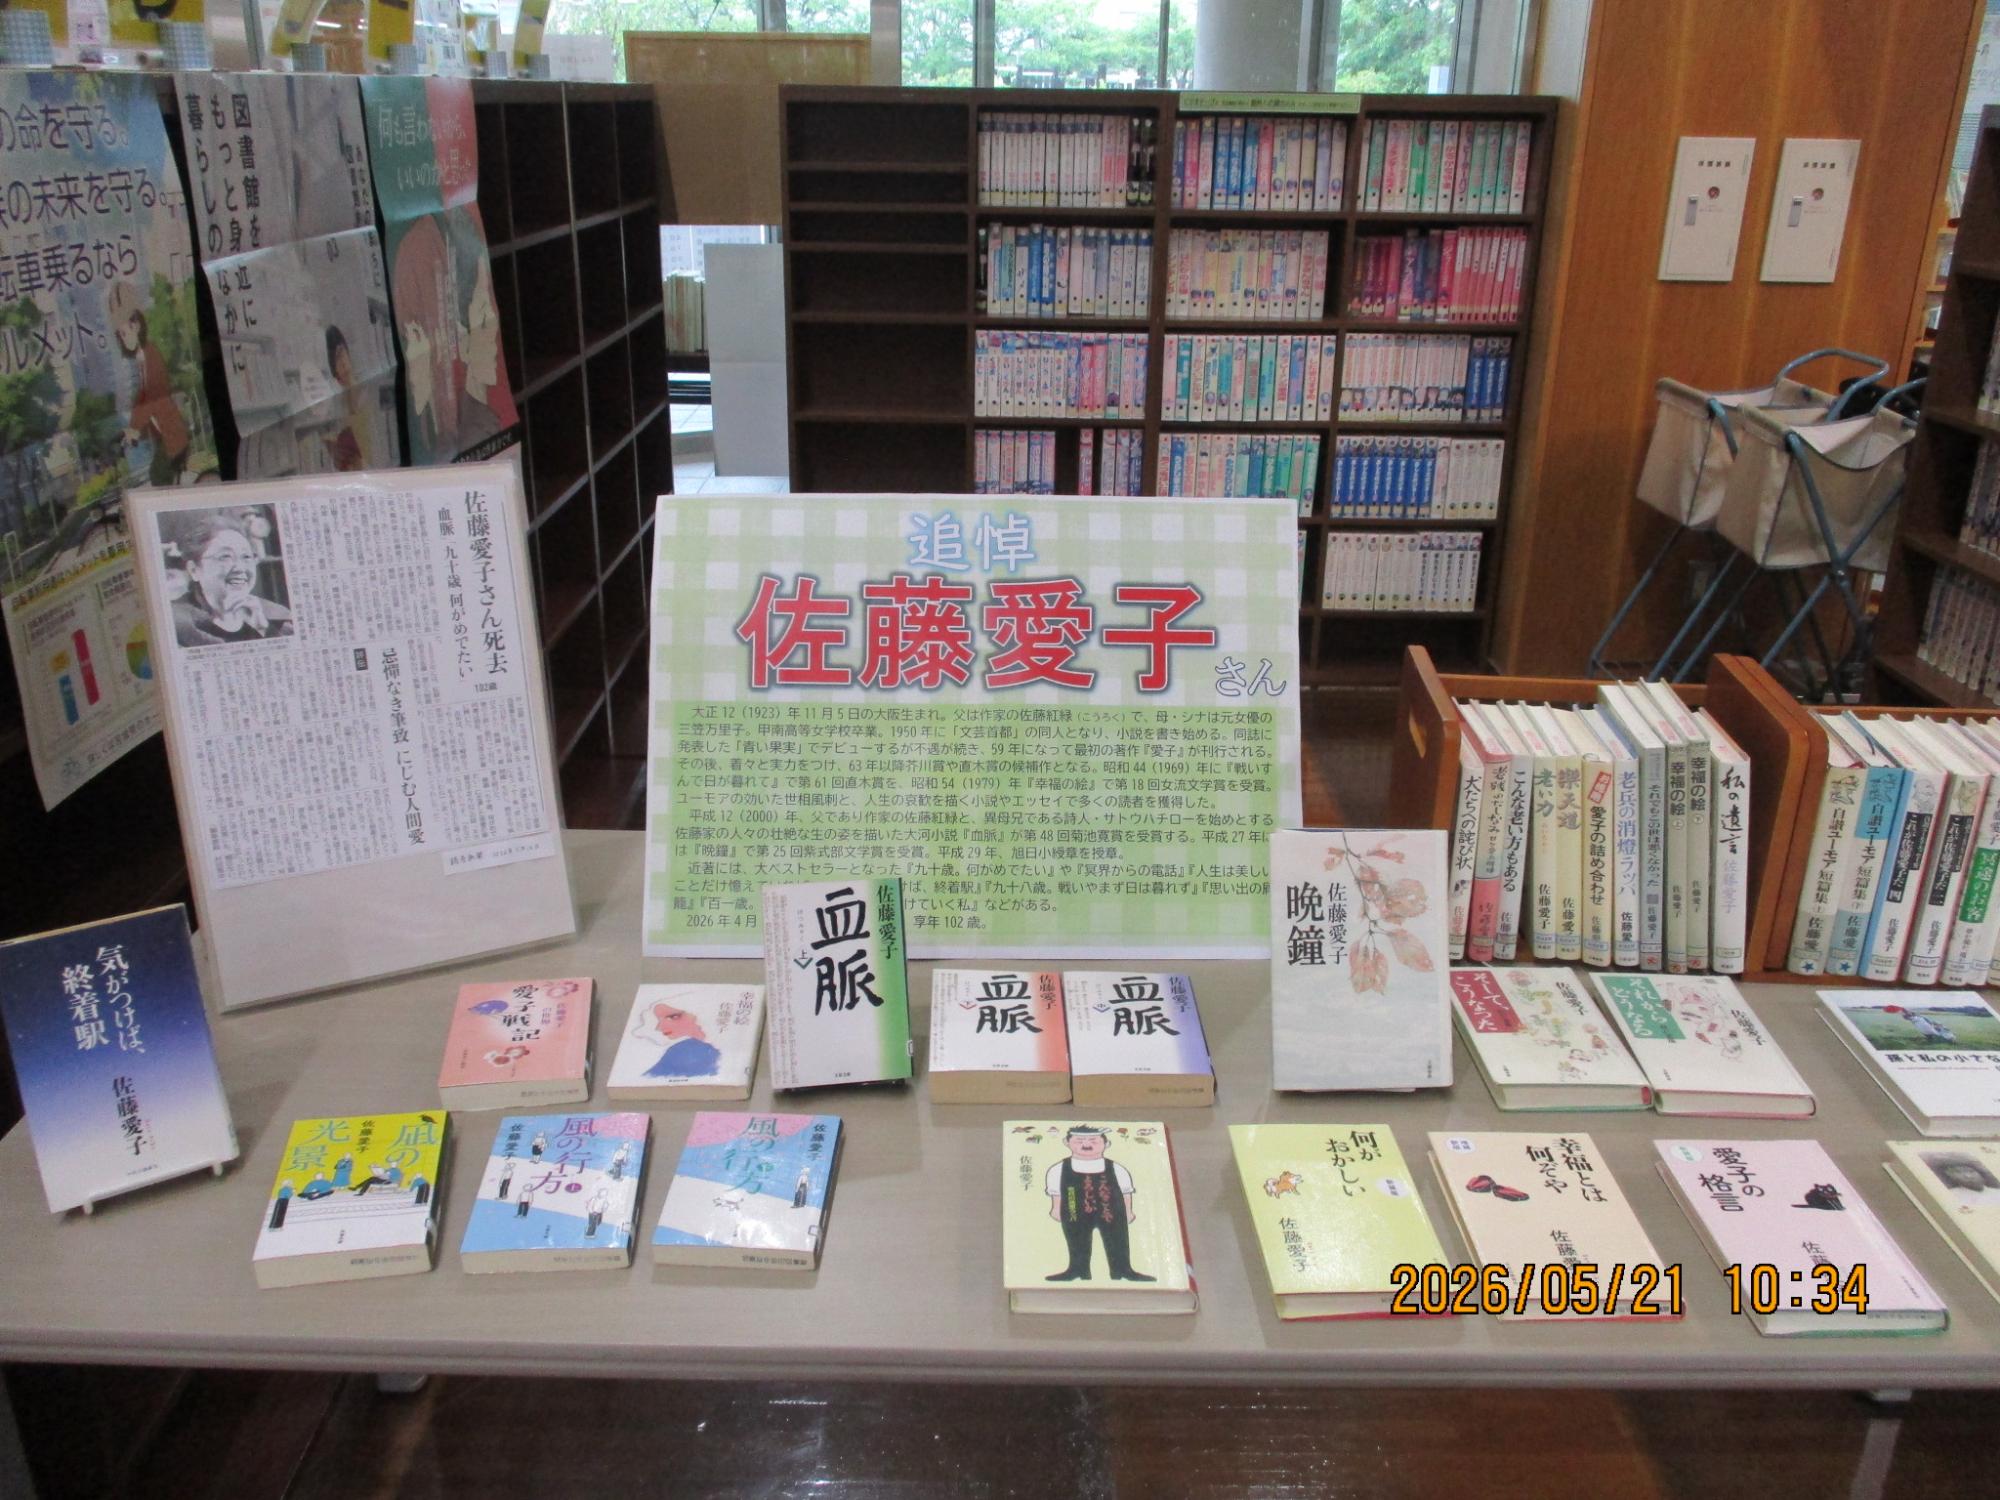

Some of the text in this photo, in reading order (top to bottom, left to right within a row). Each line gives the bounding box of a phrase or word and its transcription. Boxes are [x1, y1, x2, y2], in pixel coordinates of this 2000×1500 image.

[0, 103, 129, 151] の命を守る。
[231, 94, 261, 247] 図書館を
[907, 513, 1036, 572] 追悼
[464, 491, 507, 674] 佐藤愛子さん死去
[734, 573, 1216, 694] 佐藤愛子
[1213, 656, 1288, 698] さん
[1534, 767, 1554, 817] 老い力
[1670, 761, 1686, 816] 幸福の絵
[1690, 756, 1707, 811] 幸福の絵
[1719, 766, 1746, 856] 私の遺言
[1456, 776, 1482, 870] 犬たちへの詫び状
[1503, 770, 1527, 893] こんな老い方もある
[1616, 771, 1637, 896] 老兵の消燈ラッパ
[1589, 806, 1607, 906] 愛子の詰め合わせ
[1538, 883, 1552, 930] 佐藤愛子
[1721, 859, 1739, 915] 佐藤愛子
[810, 886, 885, 1017] 血脈
[876, 884, 899, 960] 佐藤愛子
[1286, 881, 1326, 966] 晩鐘
[1327, 882, 1348, 966] 佐藤愛子
[62, 964, 110, 1050] 終着駅
[96, 943, 146, 1054] 気がつけば、
[976, 973, 1043, 1034] 血脈
[1039, 973, 1057, 1011] 佐藤愛子
[1108, 975, 1181, 1037] 血脈
[1168, 975, 1192, 1014] 佐藤愛子
[1628, 977, 1667, 1024] それから
[112, 1076, 148, 1156] 佐藤愛子
[286, 1119, 351, 1172] 光景
[1349, 1130, 1382, 1162] 何が
[531, 1117, 597, 1195] 風の行方
[723, 1116, 780, 1195] 風の行方
[1019, 1154, 1034, 1191] 佐藤愛子
[1325, 1138, 1367, 1198] おかしい
[1526, 1144, 1568, 1194] 何ぞや
[1552, 1137, 1608, 1202] 幸福とは
[1712, 1146, 1765, 1198] 愛子の
[1698, 1172, 1744, 1212] 格言
[1278, 1216, 1311, 1273] 佐藤愛子
